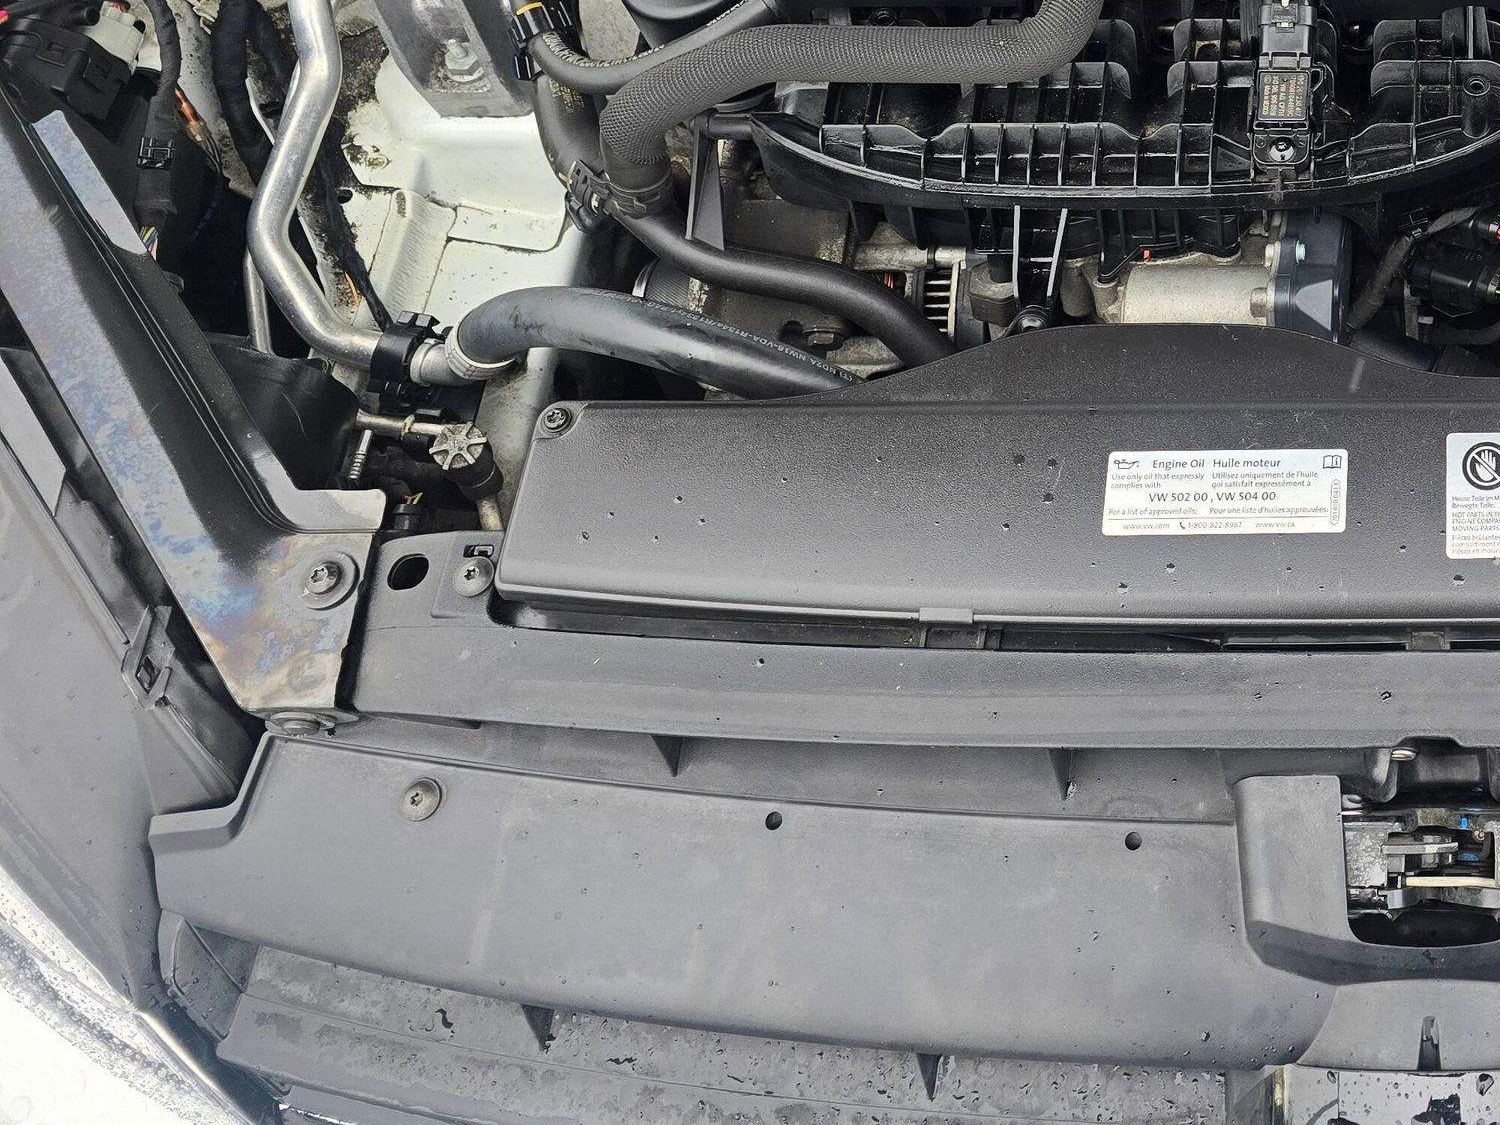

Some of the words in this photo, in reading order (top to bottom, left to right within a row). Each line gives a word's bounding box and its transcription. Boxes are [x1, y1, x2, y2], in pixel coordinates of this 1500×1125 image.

[1152, 459, 1188, 471] Engine
[1190, 458, 1205, 468] Oil
[1213, 458, 1240, 468] Huile
[1243, 459, 1281, 468] moteur
[1126, 473, 1142, 482] only
[1171, 472, 1205, 481] expressly
[1110, 482, 1143, 490] complies
[1149, 492, 1168, 502] VW
[1171, 492, 1190, 502] 502
[1193, 492, 1208, 502] 00
[1216, 492, 1235, 501] VW
[1238, 492, 1258, 501] 504
[1261, 491, 1276, 500] 00
